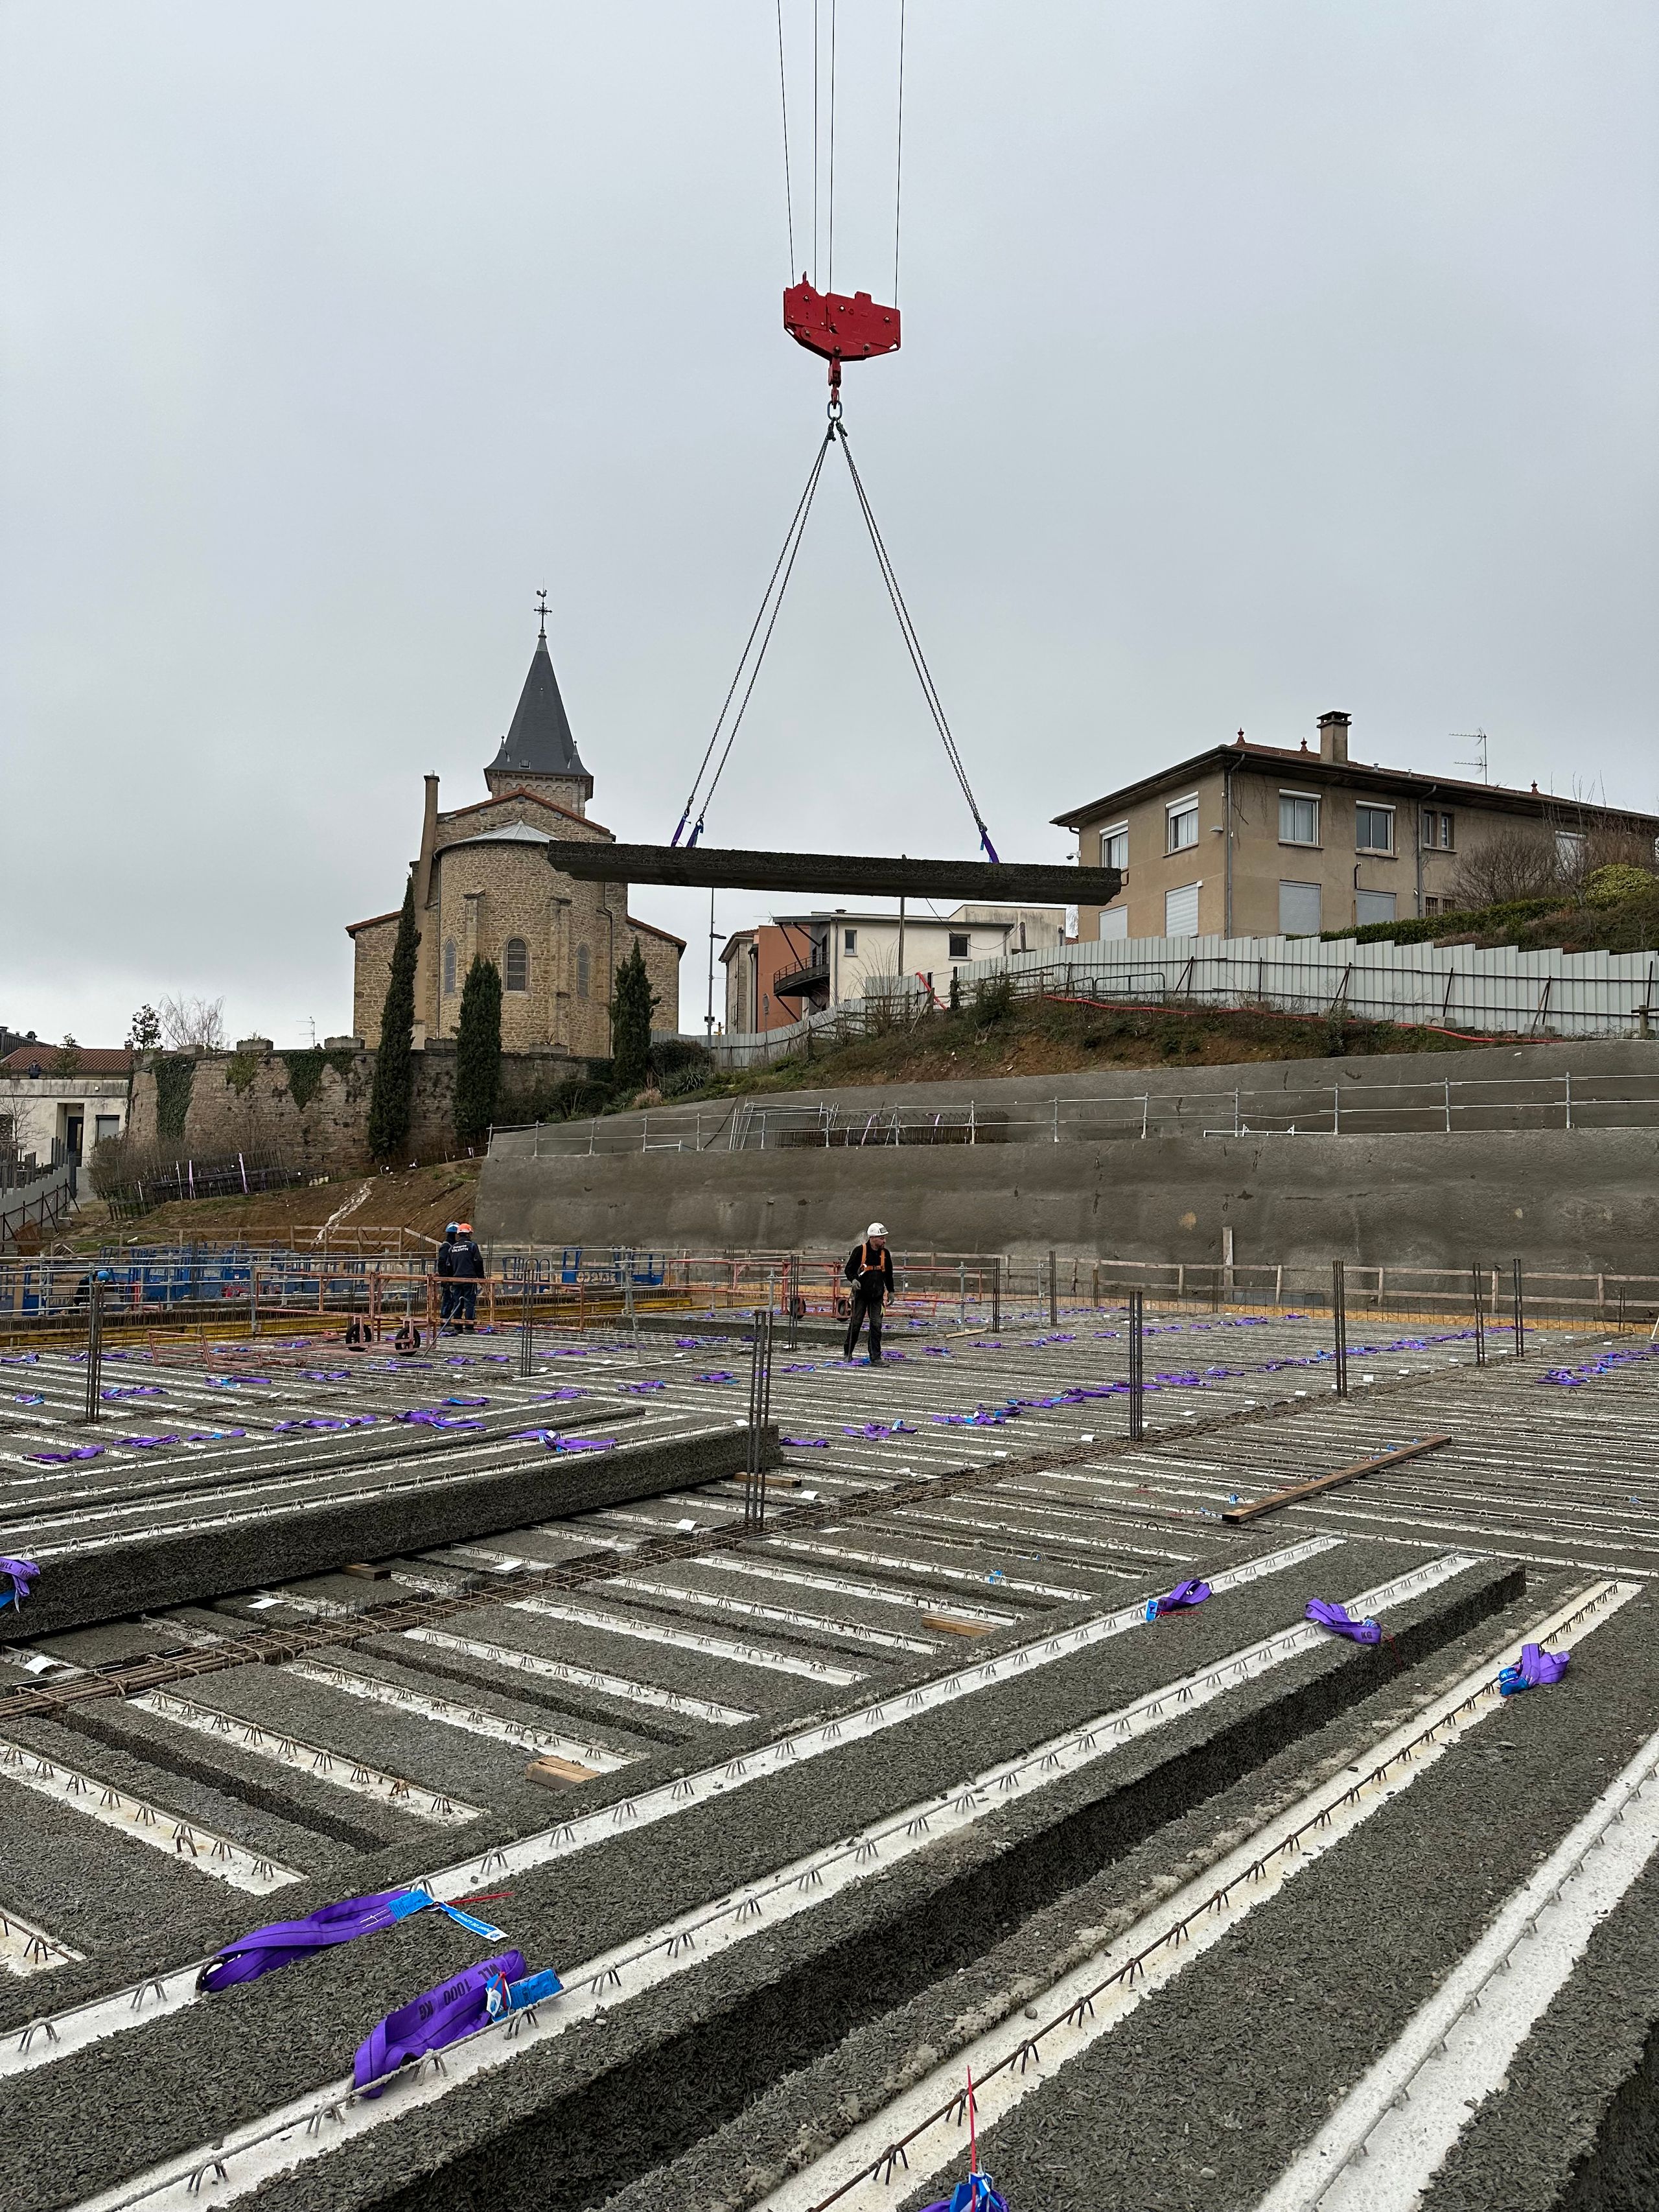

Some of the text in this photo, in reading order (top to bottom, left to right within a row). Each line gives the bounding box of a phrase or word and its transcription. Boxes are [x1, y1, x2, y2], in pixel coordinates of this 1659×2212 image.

[1361, 1631, 1373, 1639] KG
[419, 1963, 500, 2021] WLL 1000 KG
